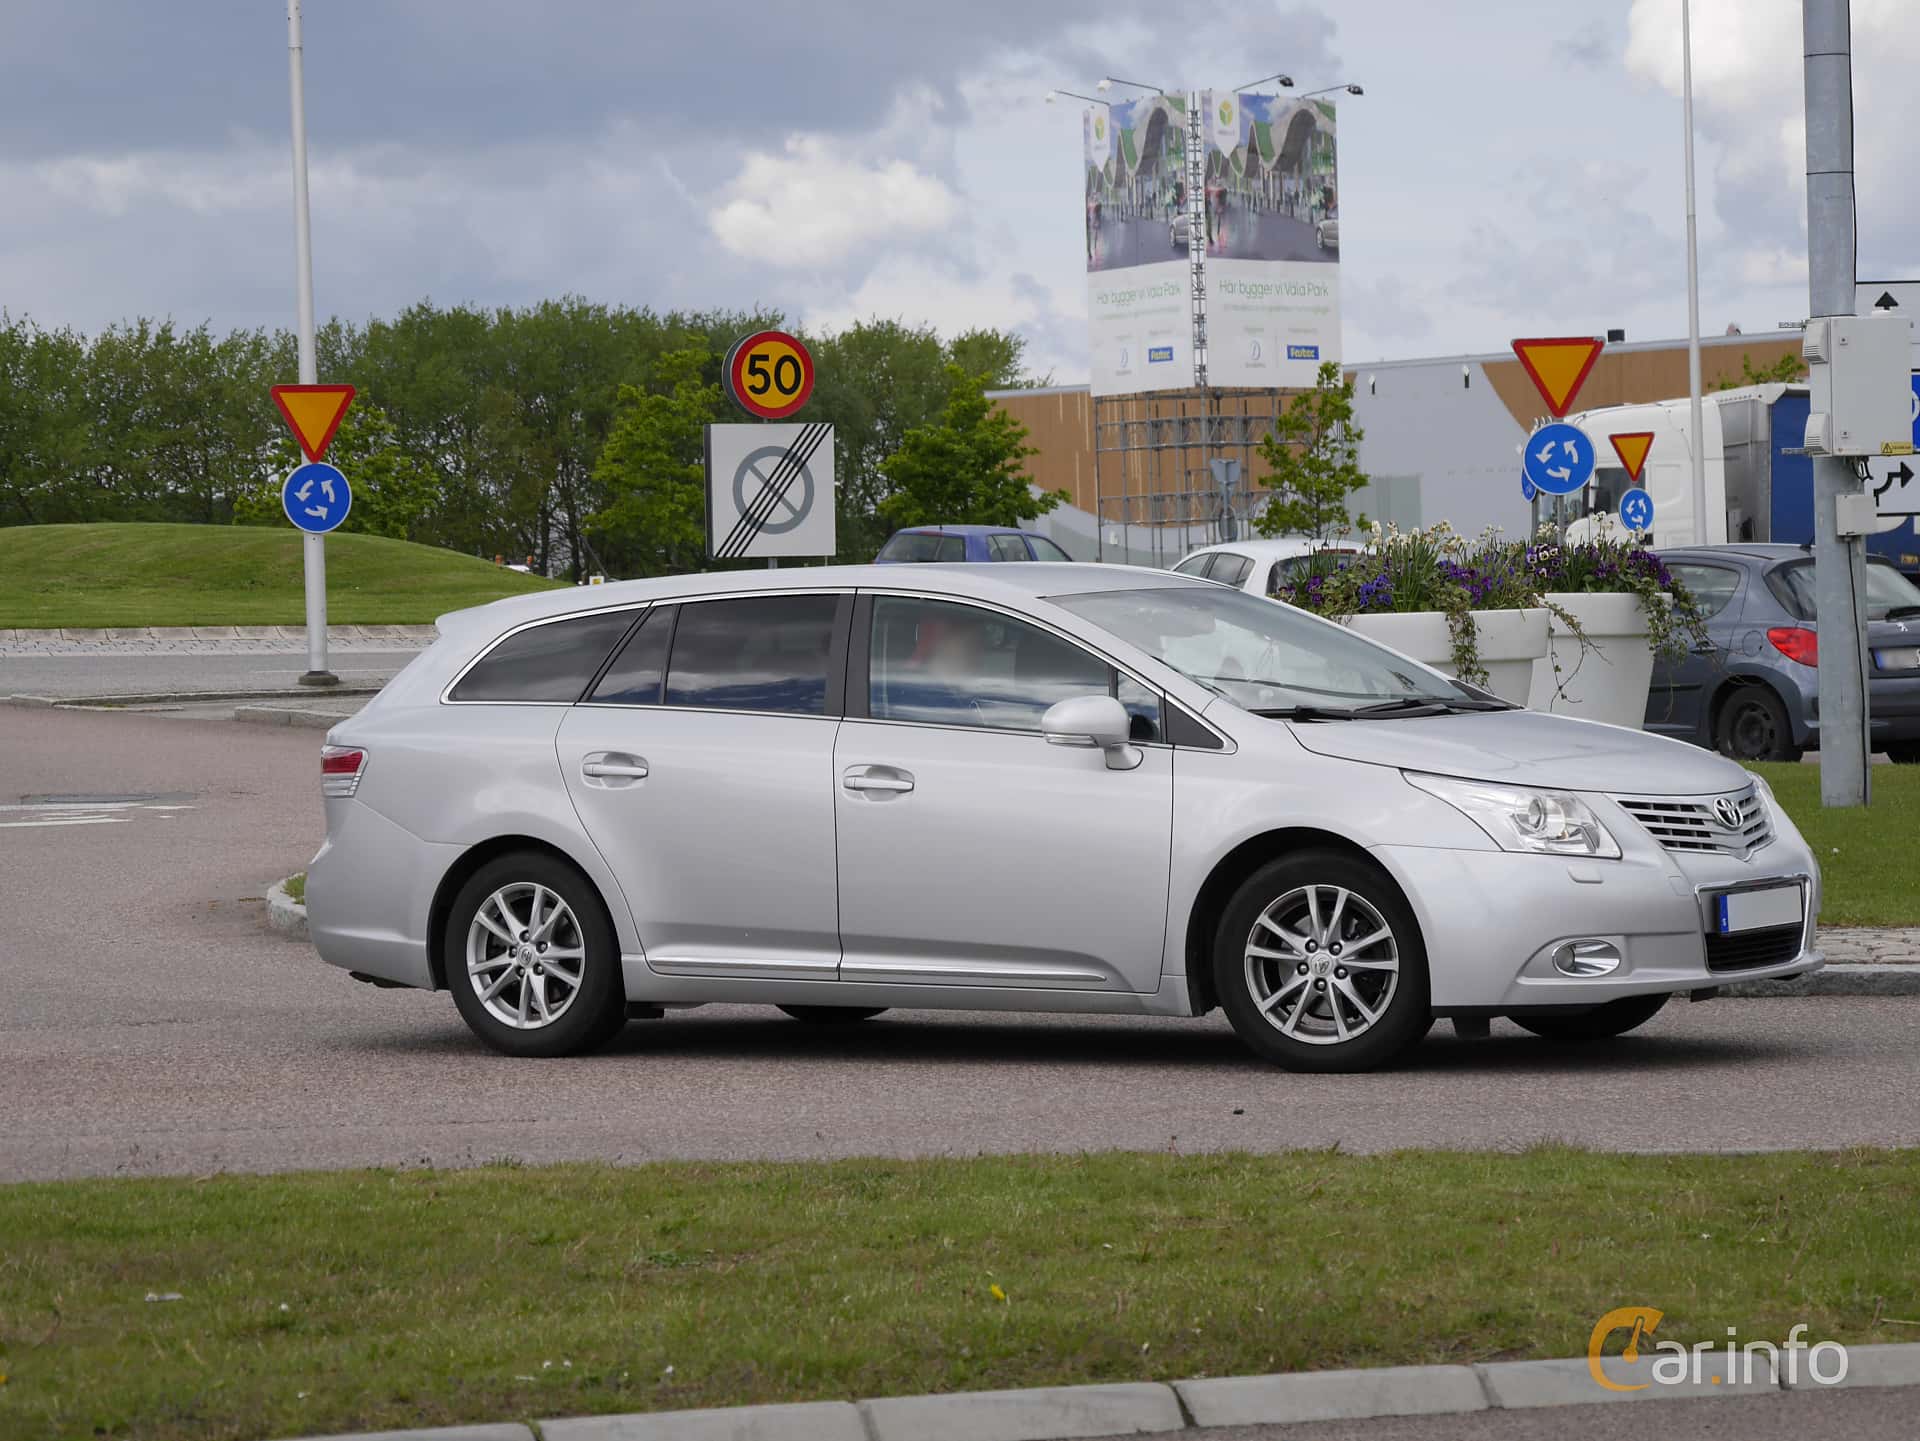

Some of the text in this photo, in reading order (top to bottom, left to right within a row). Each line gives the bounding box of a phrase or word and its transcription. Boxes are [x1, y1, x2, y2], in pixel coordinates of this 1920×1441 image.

[1238, 280, 1273, 299] bygger
[1275, 281, 1284, 295] vi
[1307, 281, 1329, 297] Park
[748, 354, 801, 395] 50
